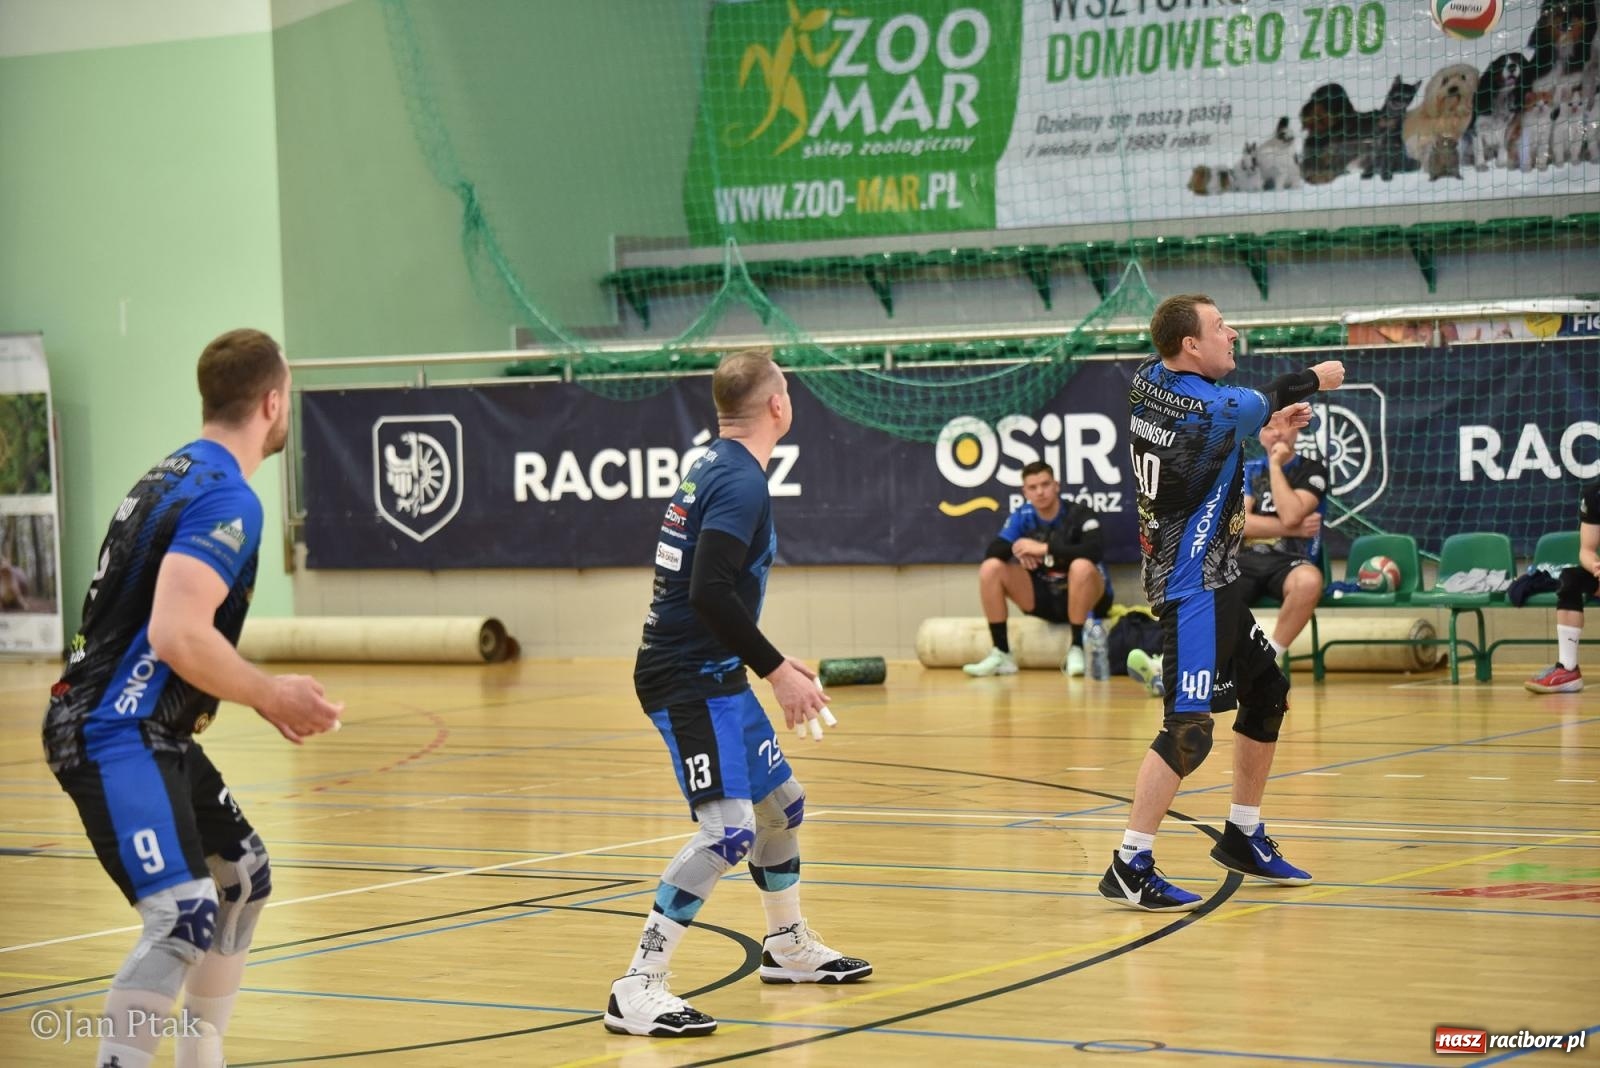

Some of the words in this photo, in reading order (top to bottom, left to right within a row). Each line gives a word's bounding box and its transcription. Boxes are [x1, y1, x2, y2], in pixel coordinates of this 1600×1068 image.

[828, 8, 991, 77] ZOO
[1046, 12, 1285, 83] DOMOWEGO
[1300, 2, 1386, 60] ZOO
[807, 72, 980, 138] MAR
[1036, 112, 1103, 134] Dzielimy
[1108, 111, 1132, 132] się
[1136, 109, 1183, 129] naszą
[1187, 102, 1233, 125] pasją
[802, 139, 853, 160] sklep
[859, 135, 975, 156] zoologiczny
[714, 171, 963, 224] WWW.ZOO-MAR.PL
[1132, 374, 1203, 411] RESTAURACJA
[935, 413, 1122, 488] OSiR
[1130, 414, 1176, 447] WROŃSKI
[1459, 421, 1600, 481] RAC
[1130, 443, 1161, 500] 40
[1182, 670, 1211, 700] 40
[685, 753, 712, 791] 13
[133, 828, 165, 874] 9
